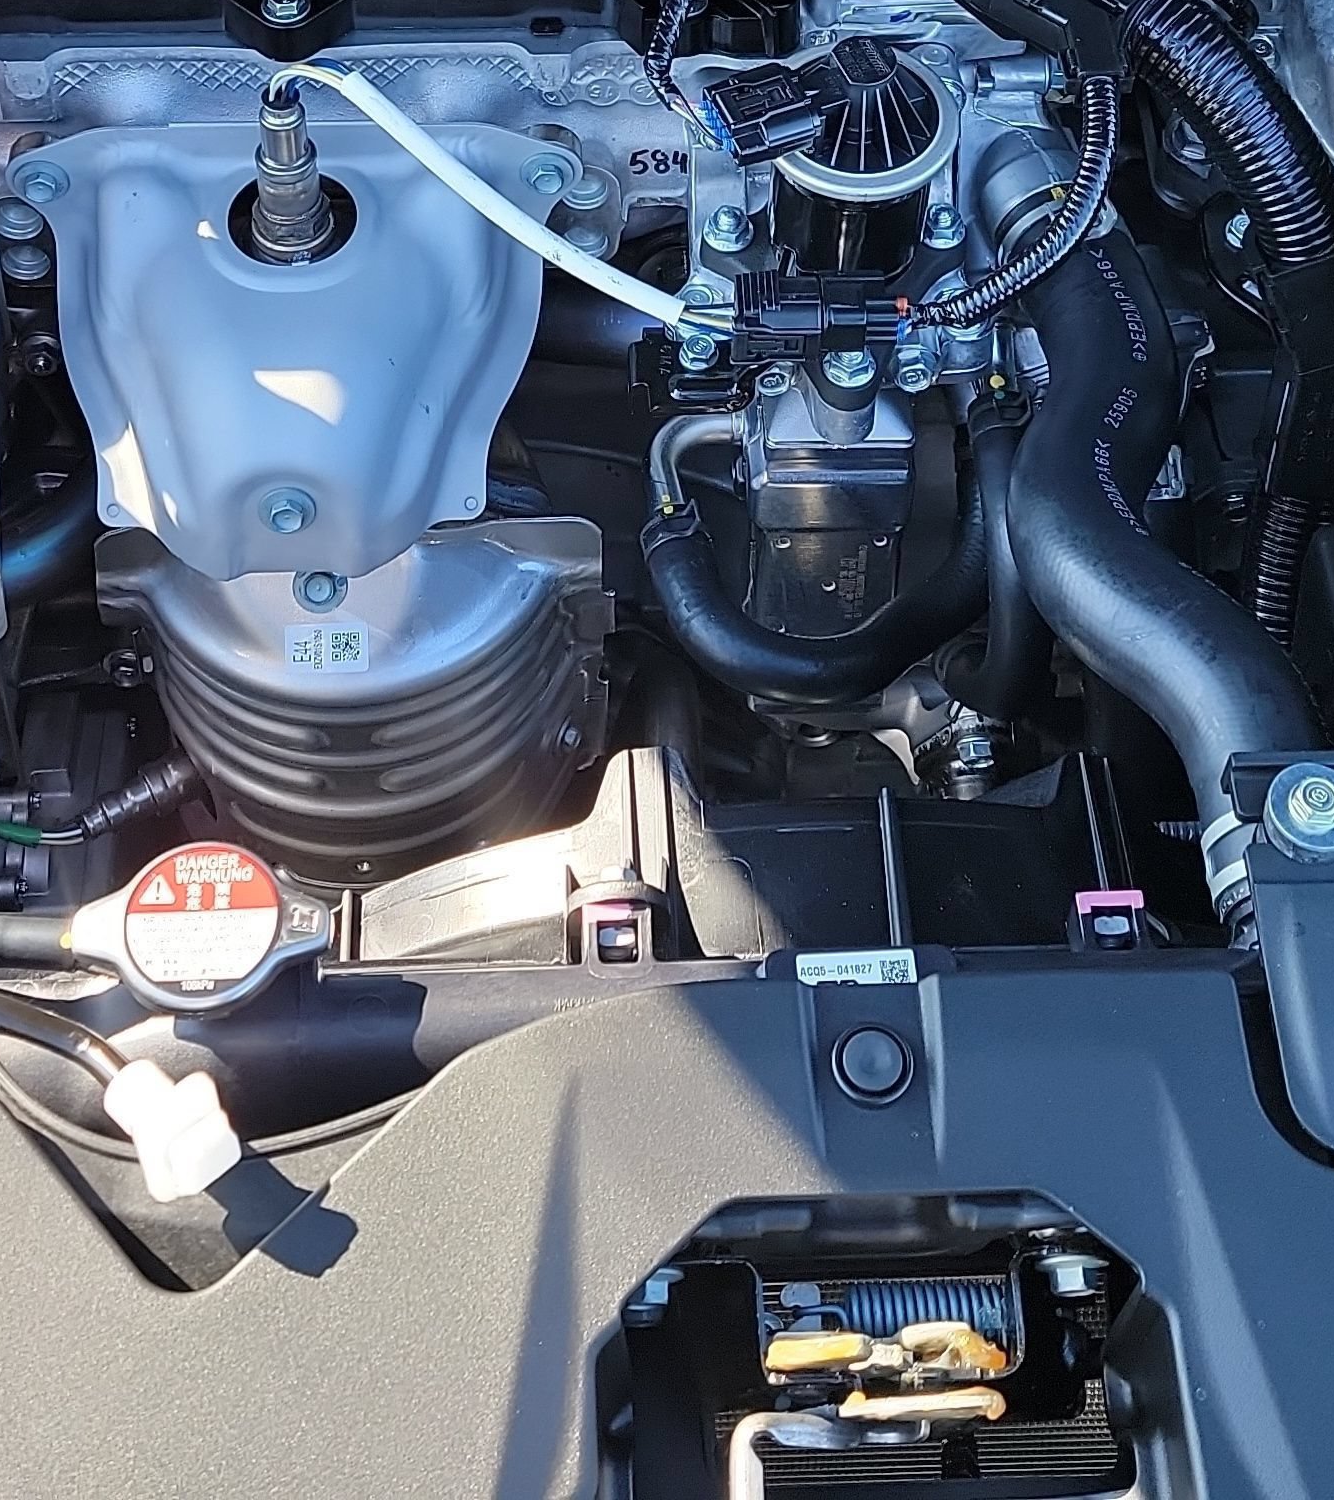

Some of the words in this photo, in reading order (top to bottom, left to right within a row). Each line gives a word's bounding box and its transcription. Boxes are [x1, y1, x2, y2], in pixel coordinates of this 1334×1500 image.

[629, 149, 688, 174] 584
[1104, 387, 1140, 430] 25905
[293, 641, 312, 663] E44
[174, 854, 240, 871] DANGER
[176, 866, 254, 884] WARNUNG
